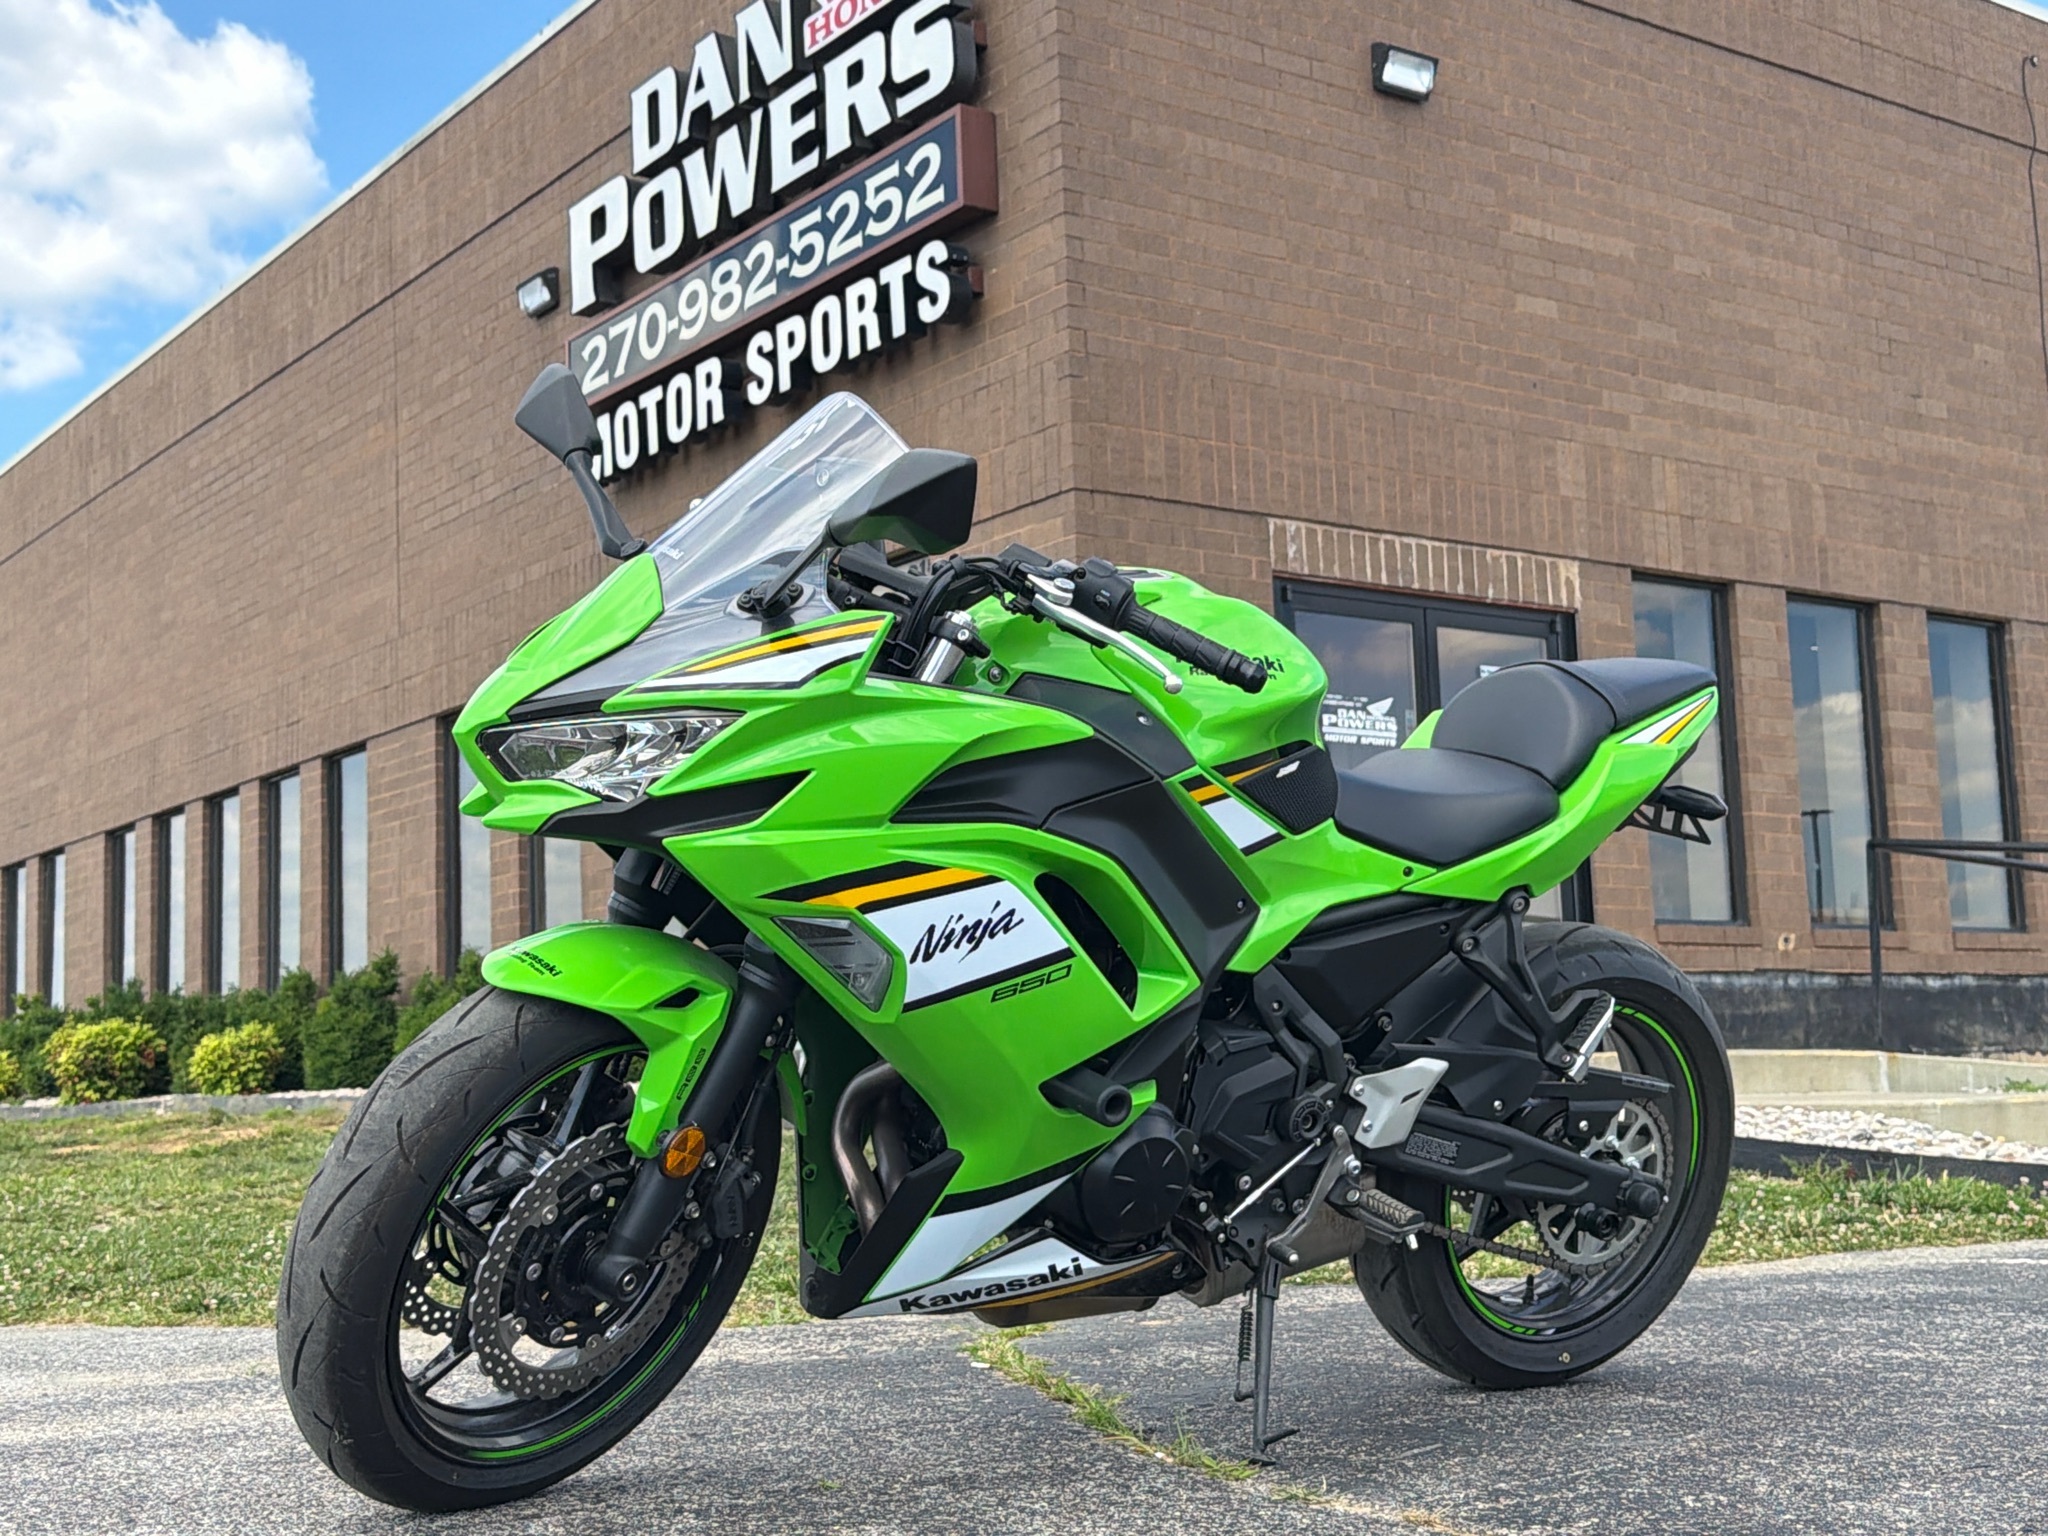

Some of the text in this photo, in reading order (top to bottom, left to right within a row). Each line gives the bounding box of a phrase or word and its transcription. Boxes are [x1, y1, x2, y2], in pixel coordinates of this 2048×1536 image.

[630, 0, 795, 176] DAN
[567, 0, 955, 317] POWERS
[580, 142, 945, 396] 270-982-5252
[745, 239, 952, 407] SPORTS
[510, 946, 564, 977] wasaki
[909, 899, 1025, 964] Ninja
[990, 963, 1073, 1003] 650
[898, 1256, 1084, 1313] Kawasaki
